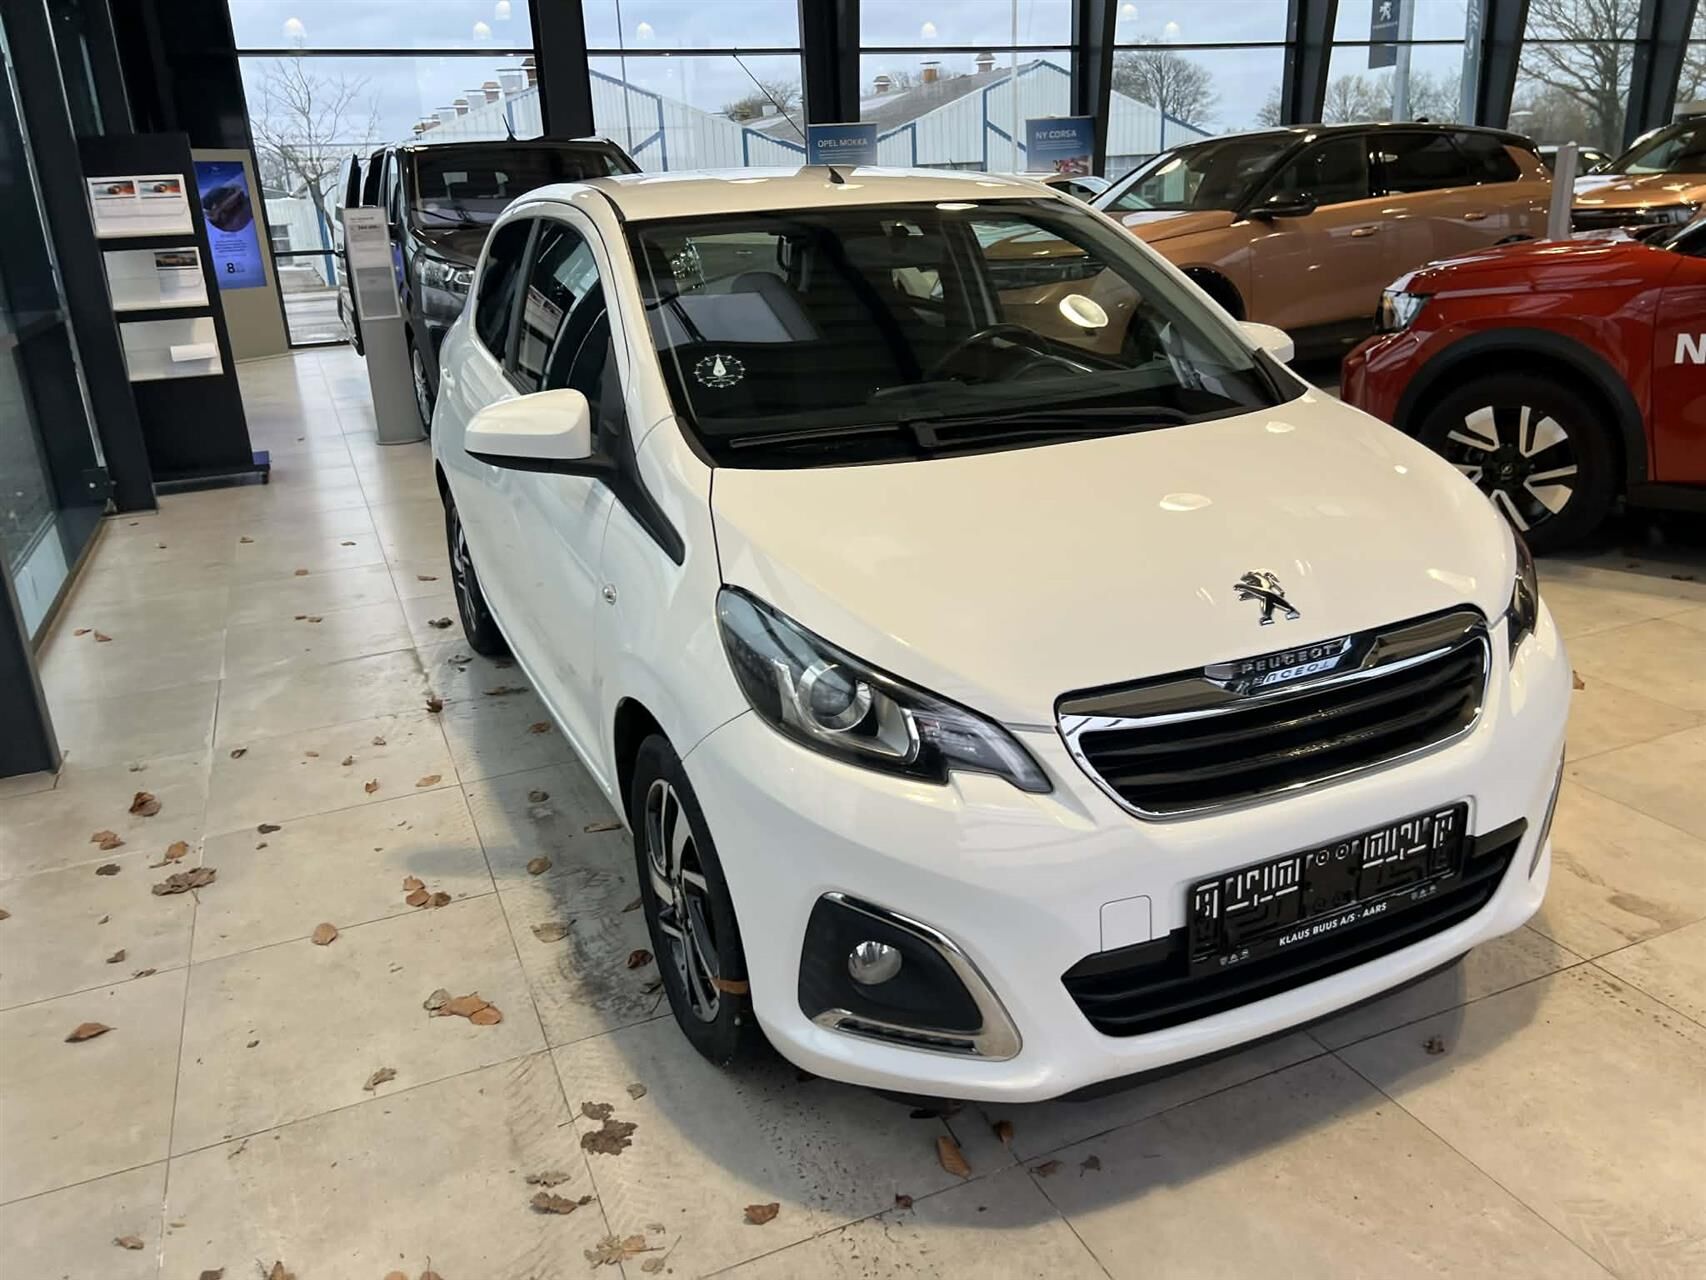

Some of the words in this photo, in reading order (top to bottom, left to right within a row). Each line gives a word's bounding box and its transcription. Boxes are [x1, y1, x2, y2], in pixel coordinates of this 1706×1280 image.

[817, 139, 839, 148] OPEL
[840, 137, 868, 147] MOKKA
[1035, 131, 1048, 140] NY
[1049, 129, 1077, 139] CORSA
[1241, 645, 1334, 675] PEUGEOT
[1279, 928, 1310, 946] KLAUS
[1312, 919, 1338, 935] BUUS
[1340, 912, 1355, 926] A/S
[1362, 902, 1387, 918] AARS
